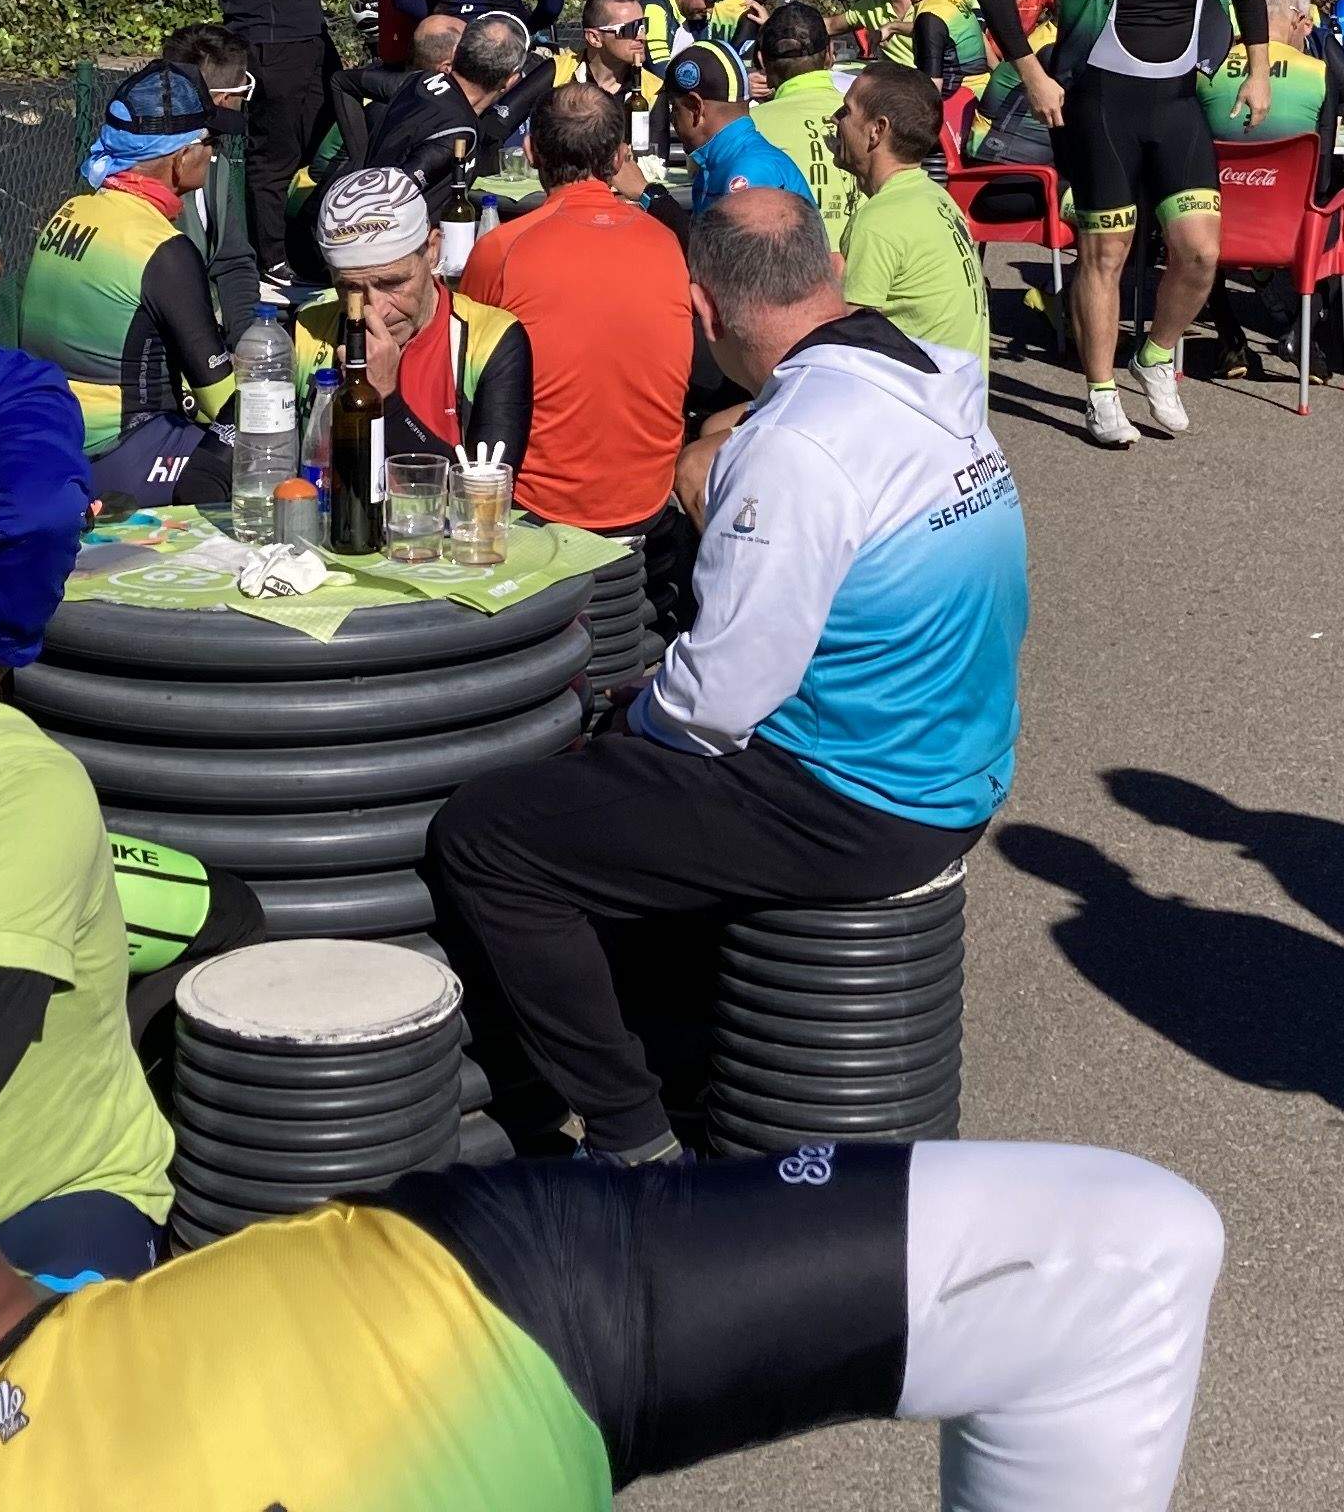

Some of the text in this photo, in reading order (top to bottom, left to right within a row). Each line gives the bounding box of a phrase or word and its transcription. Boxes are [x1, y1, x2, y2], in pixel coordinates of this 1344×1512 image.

[1099, 211, 1136, 229] SAM
[40, 216, 99, 262] SAMI
[929, 488, 992, 532] SERGIO
[111, 843, 160, 867] IKE
